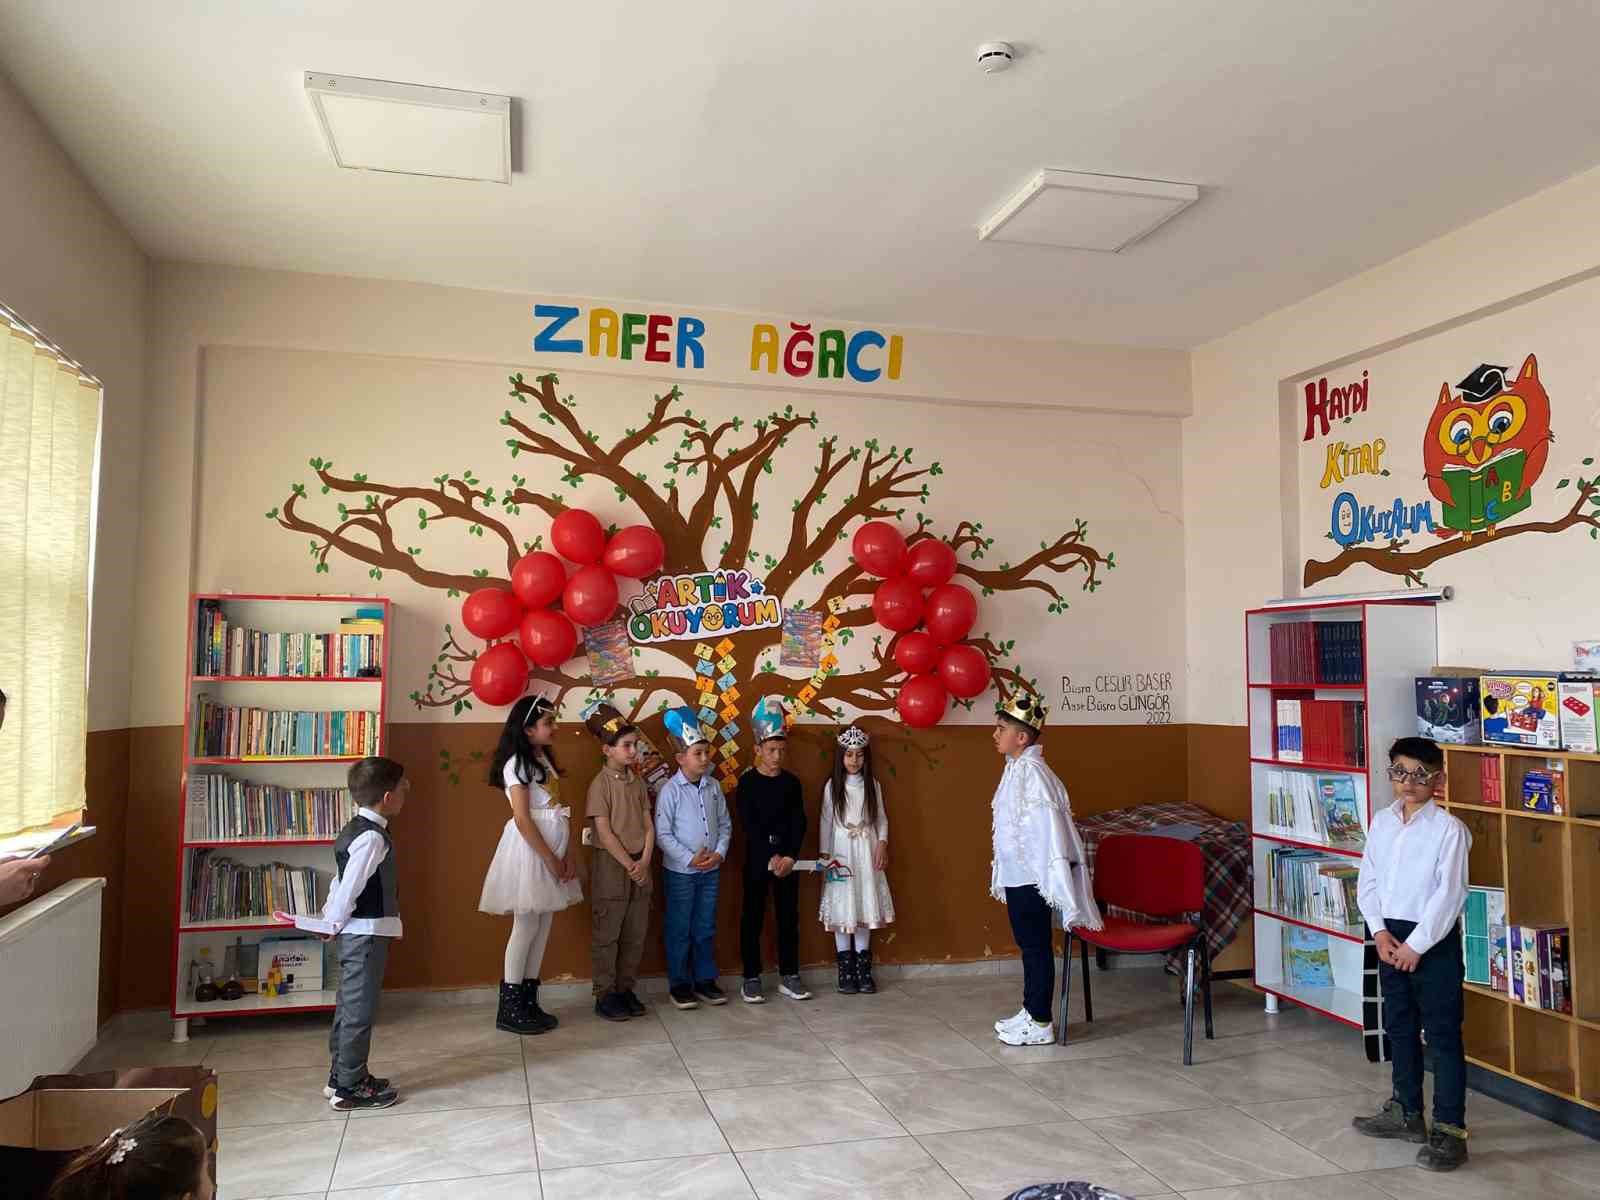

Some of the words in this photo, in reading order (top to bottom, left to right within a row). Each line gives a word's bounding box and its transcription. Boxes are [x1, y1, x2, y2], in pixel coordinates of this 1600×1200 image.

[534, 304, 705, 369] ZAFER
[750, 321, 904, 383] AĞACI
[1485, 467, 1499, 488] A
[1502, 481, 1512, 502] B
[1485, 500, 1499, 520] C
[630, 598, 778, 640] OKUYORUM
